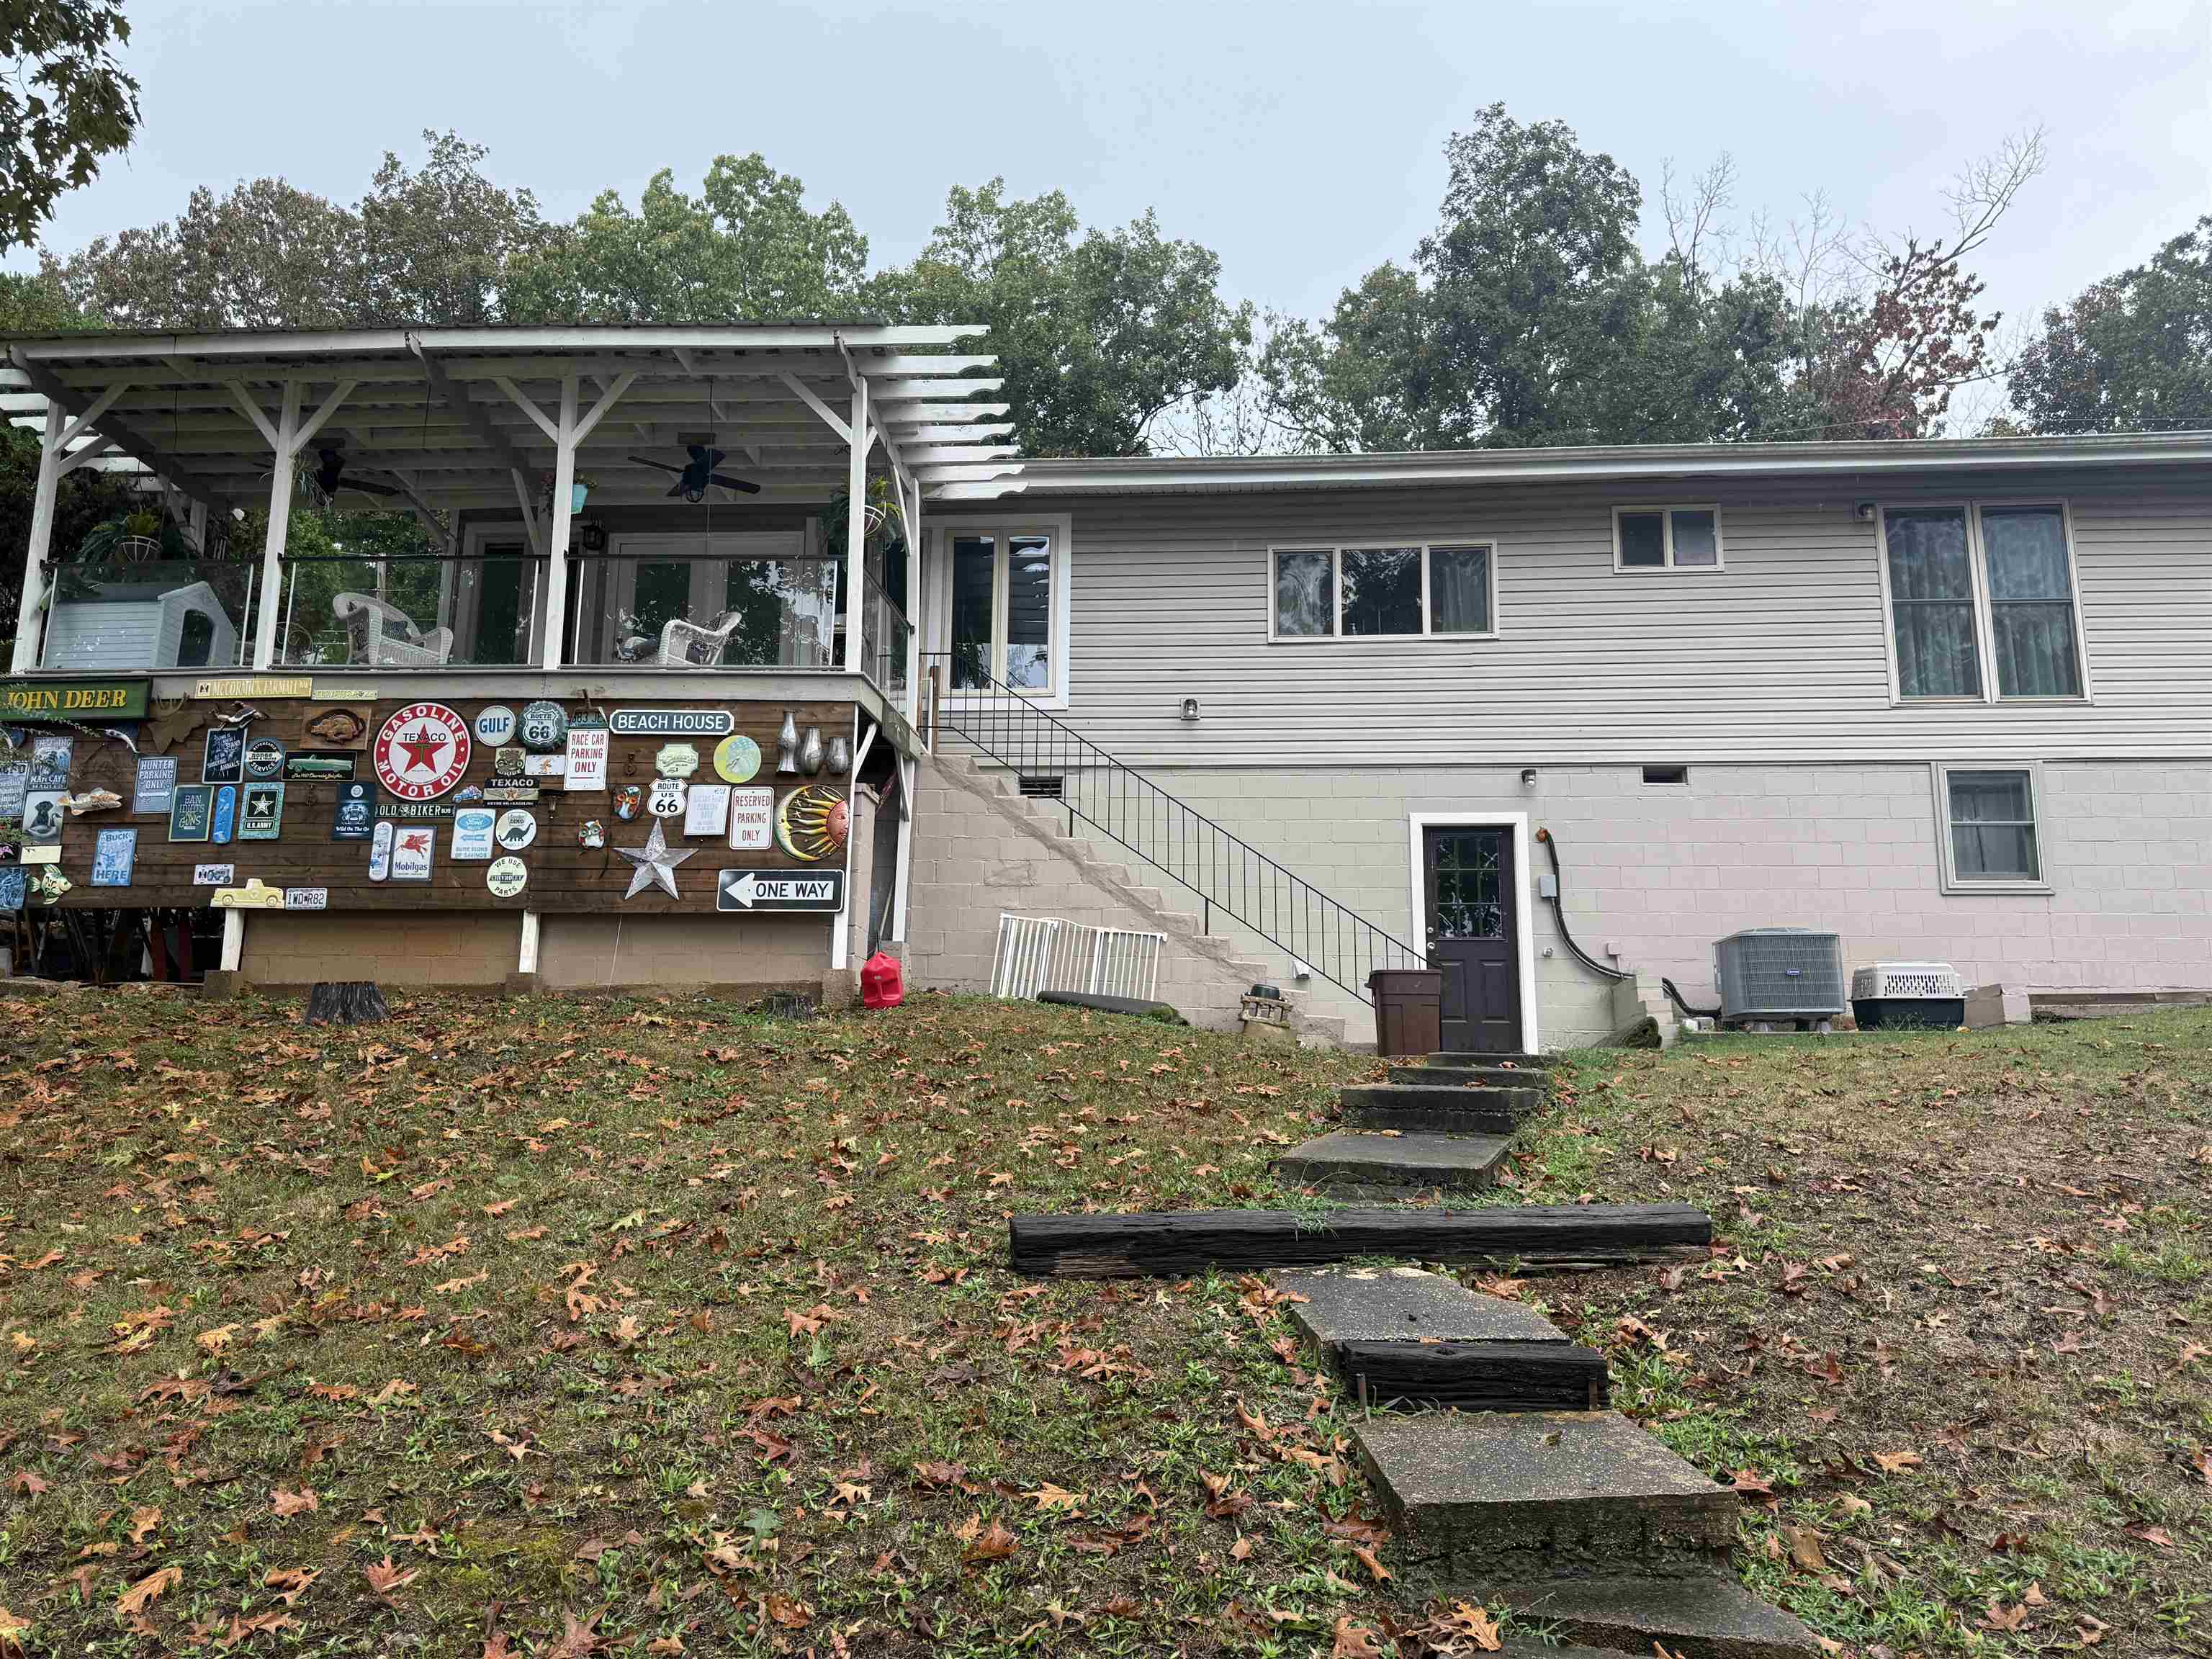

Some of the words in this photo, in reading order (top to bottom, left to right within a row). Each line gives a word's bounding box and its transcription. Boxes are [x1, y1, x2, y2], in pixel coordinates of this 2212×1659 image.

[6, 691, 59, 709] JOHN
[63, 689, 127, 709] DEER
[382, 706, 467, 742] GASOLINE
[479, 717, 511, 734] GULF
[618, 715, 668, 729] BEACH
[673, 715, 724, 730] HOUSE
[403, 733, 446, 742] TEXACO
[529, 725, 550, 739] 66
[571, 734, 589, 745] RACE
[591, 734, 604, 745] CAR
[571, 748, 603, 759] PARKING
[140, 760, 174, 770] HUNTER
[251, 761, 276, 772] SERVICE
[575, 761, 597, 773] ONLY
[139, 770, 174, 779] PARKING
[378, 759, 435, 797] MOTOR
[441, 761, 464, 786] OIL
[145, 779, 164, 789] ONLY
[490, 778, 534, 787] TEXACO
[184, 795, 202, 804] BAN
[735, 795, 770, 807] RESERVED
[379, 805, 397, 816] OLD
[410, 805, 441, 816] BIKER
[655, 799, 678, 813] 66
[179, 815, 202, 828] GUNS
[737, 811, 766, 824] PARKING
[106, 832, 128, 842] BUCK
[742, 830, 760, 842] ONLY
[394, 862, 428, 873] Mobilgas
[495, 858, 505, 868] WE
[508, 858, 521, 868] USE
[96, 869, 127, 879] HERE
[495, 886, 518, 896] PARTS
[755, 882, 789, 898] ONE
[795, 882, 830, 898] WAY
